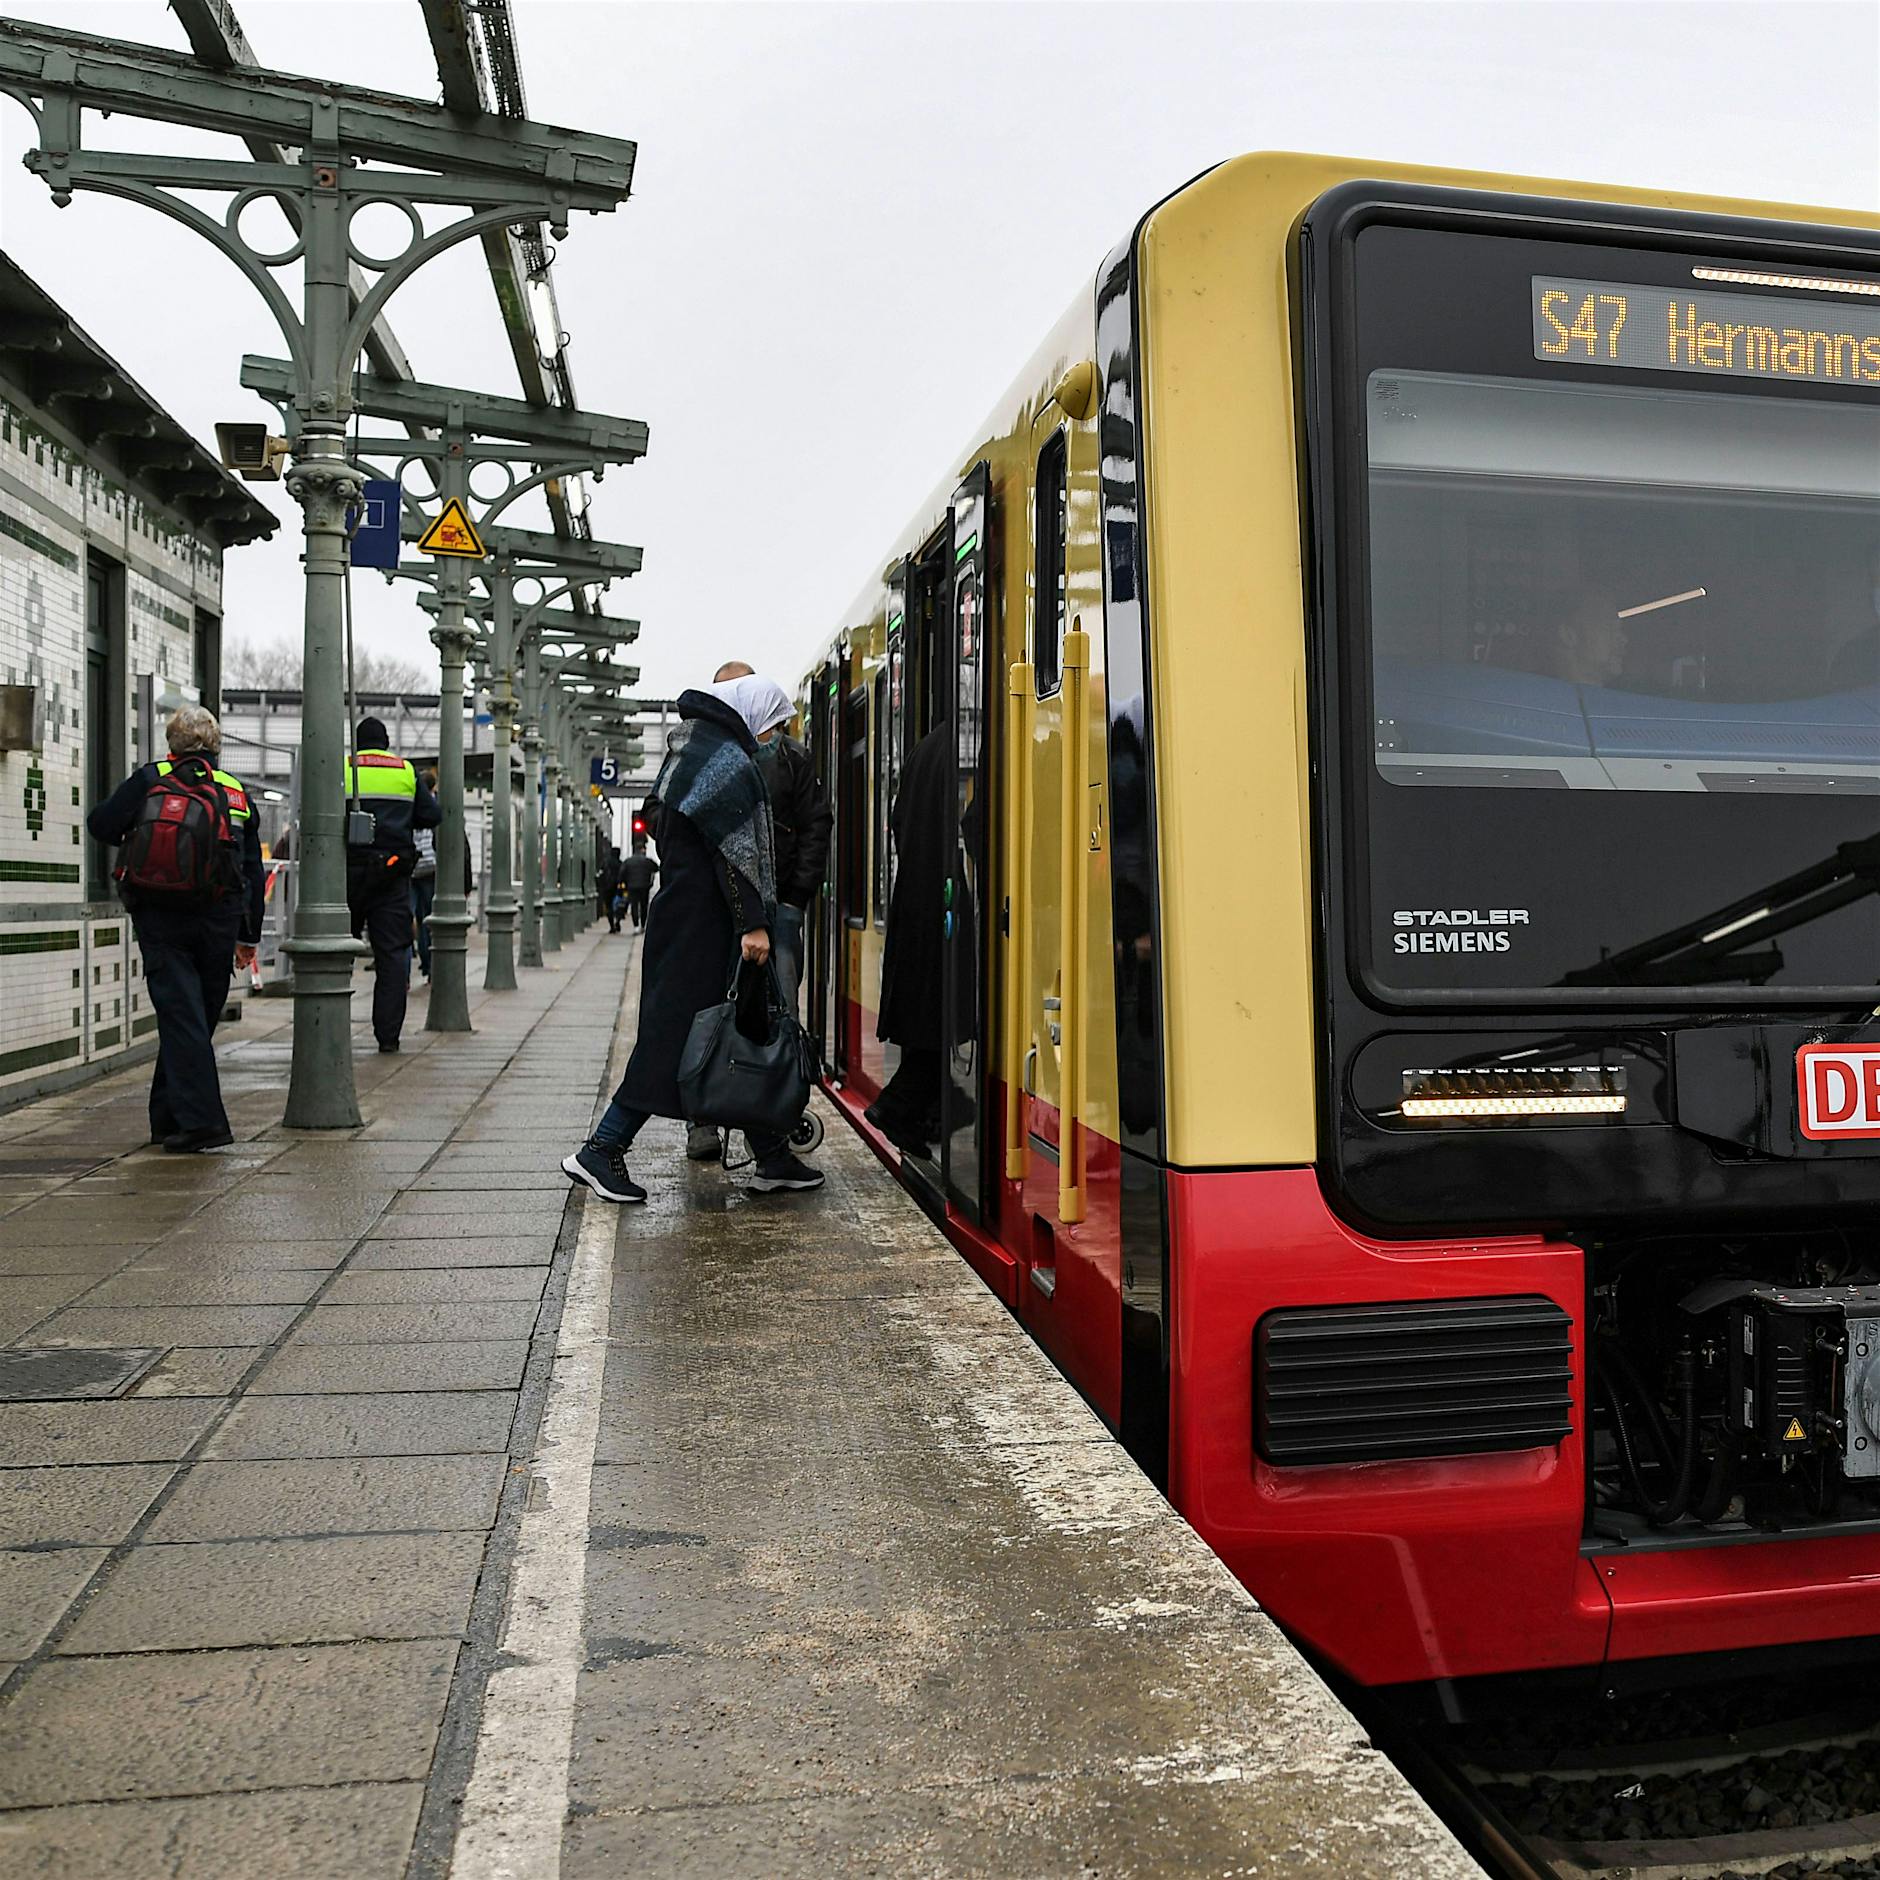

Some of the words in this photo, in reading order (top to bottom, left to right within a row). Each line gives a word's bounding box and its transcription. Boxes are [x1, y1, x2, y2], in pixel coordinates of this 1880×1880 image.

[1541, 290, 1628, 358] S47
[1668, 301, 1880, 380] Hermanns
[601, 758, 615, 780] 5
[1393, 909, 1530, 926] STADLER
[1393, 931, 1511, 953] SIEMENS
